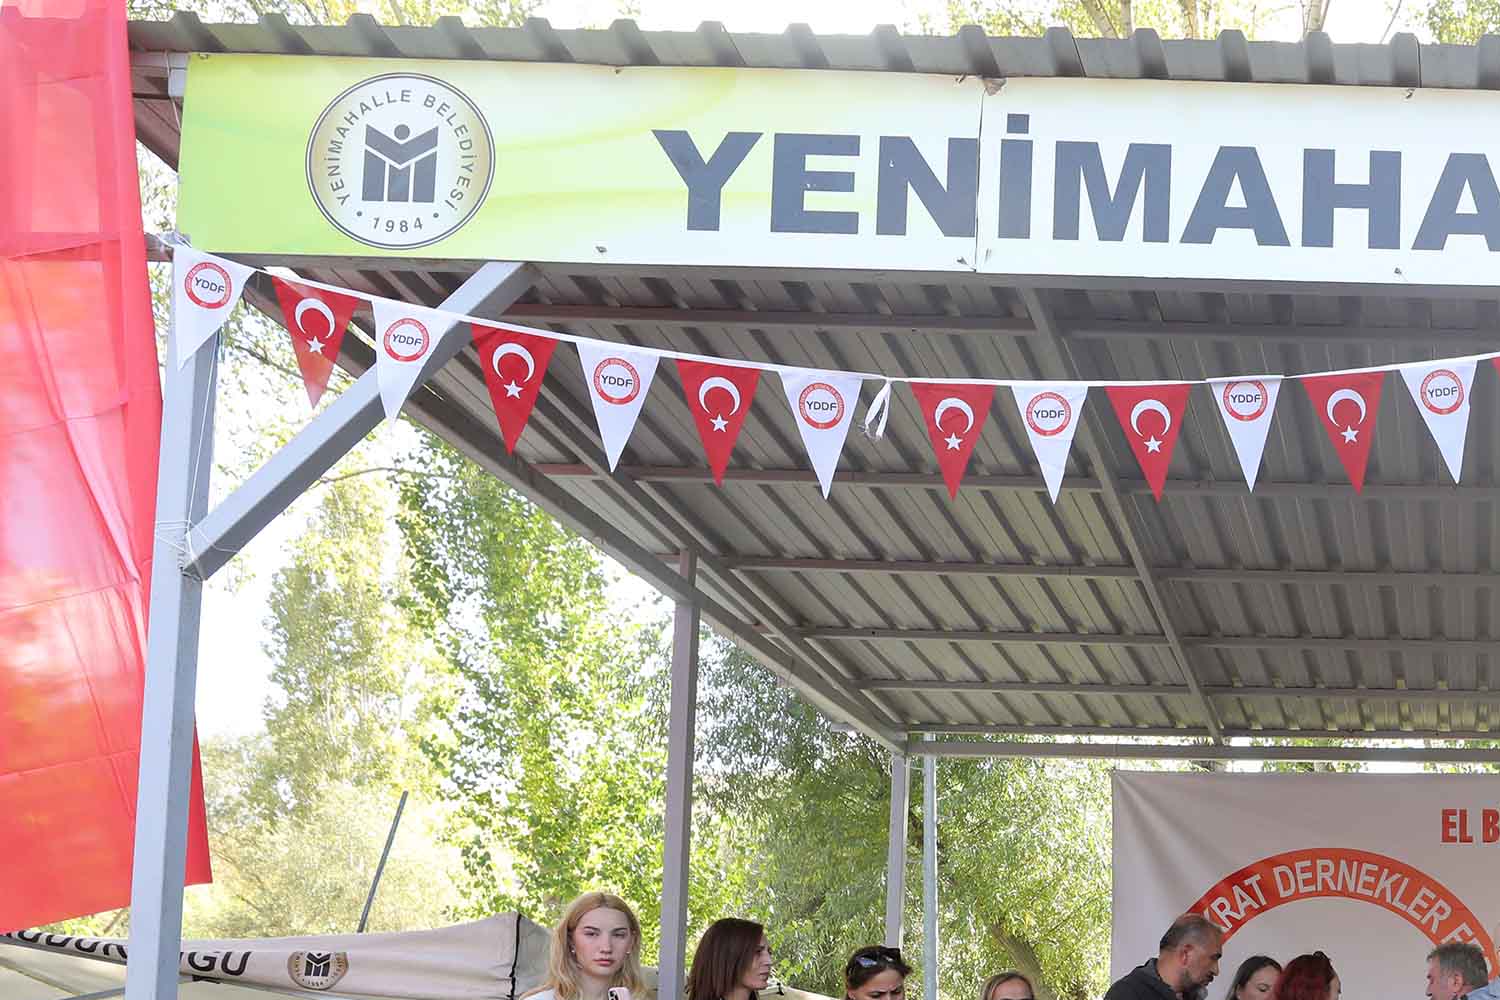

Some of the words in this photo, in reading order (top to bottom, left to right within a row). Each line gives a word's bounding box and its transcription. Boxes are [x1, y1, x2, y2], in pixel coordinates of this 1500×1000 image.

[324, 89, 412, 206] YENİMAHALLE
[423, 94, 477, 211] BELEDİYESİ
[373, 217, 423, 233] 1984
[194, 277, 224, 293] YDDF
[391, 333, 421, 346] YDDF
[601, 374, 632, 387] YDDF
[1427, 385, 1458, 397] YDDF
[1230, 393, 1260, 404] YDDF
[806, 400, 836, 411] YDDF
[1034, 409, 1064, 419] YDDF
[1441, 808, 1473, 843] EL
[1272, 858, 1452, 934] DERNEKLER
